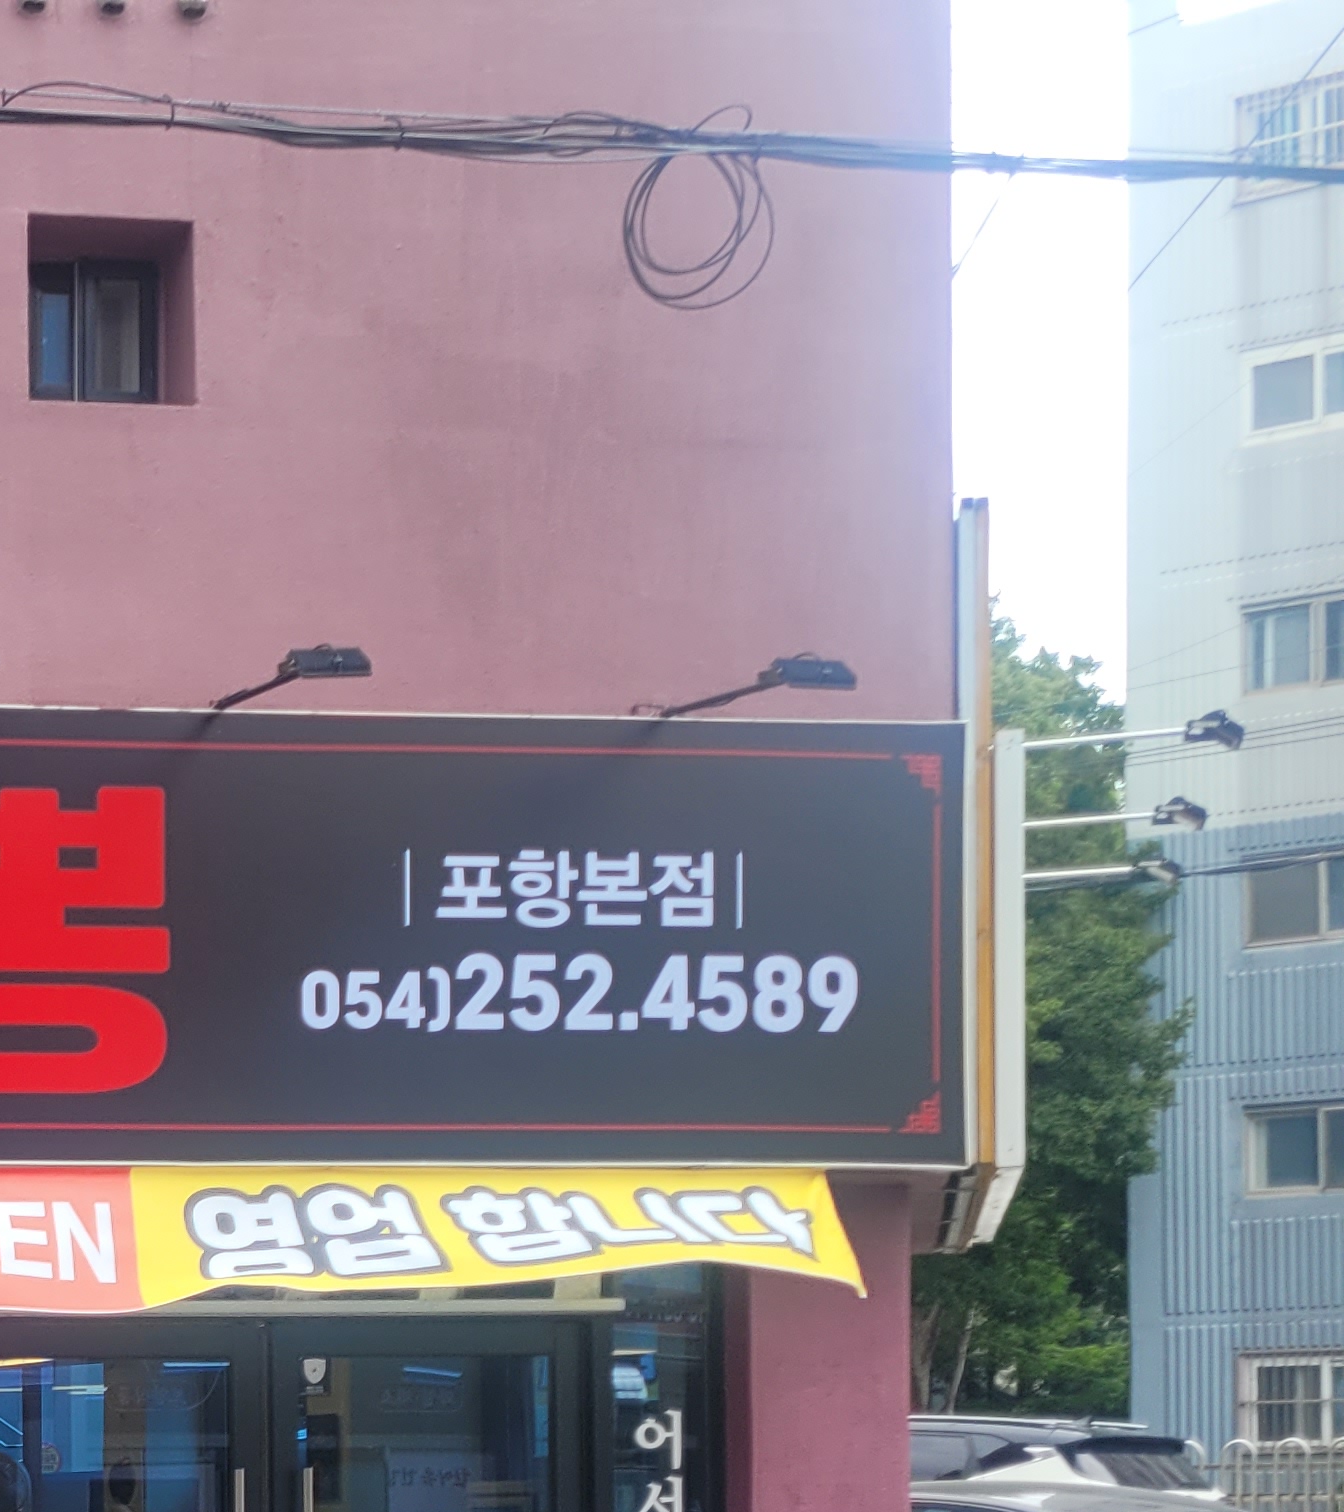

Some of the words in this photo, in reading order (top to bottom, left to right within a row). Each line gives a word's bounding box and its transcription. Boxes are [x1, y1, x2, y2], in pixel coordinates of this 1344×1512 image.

[435, 849, 717, 929] 포항본점
[299, 951, 859, 1036] 054)252.4589
[184, 1183, 447, 1279] 영업
[443, 1185, 817, 1266] 합니다
